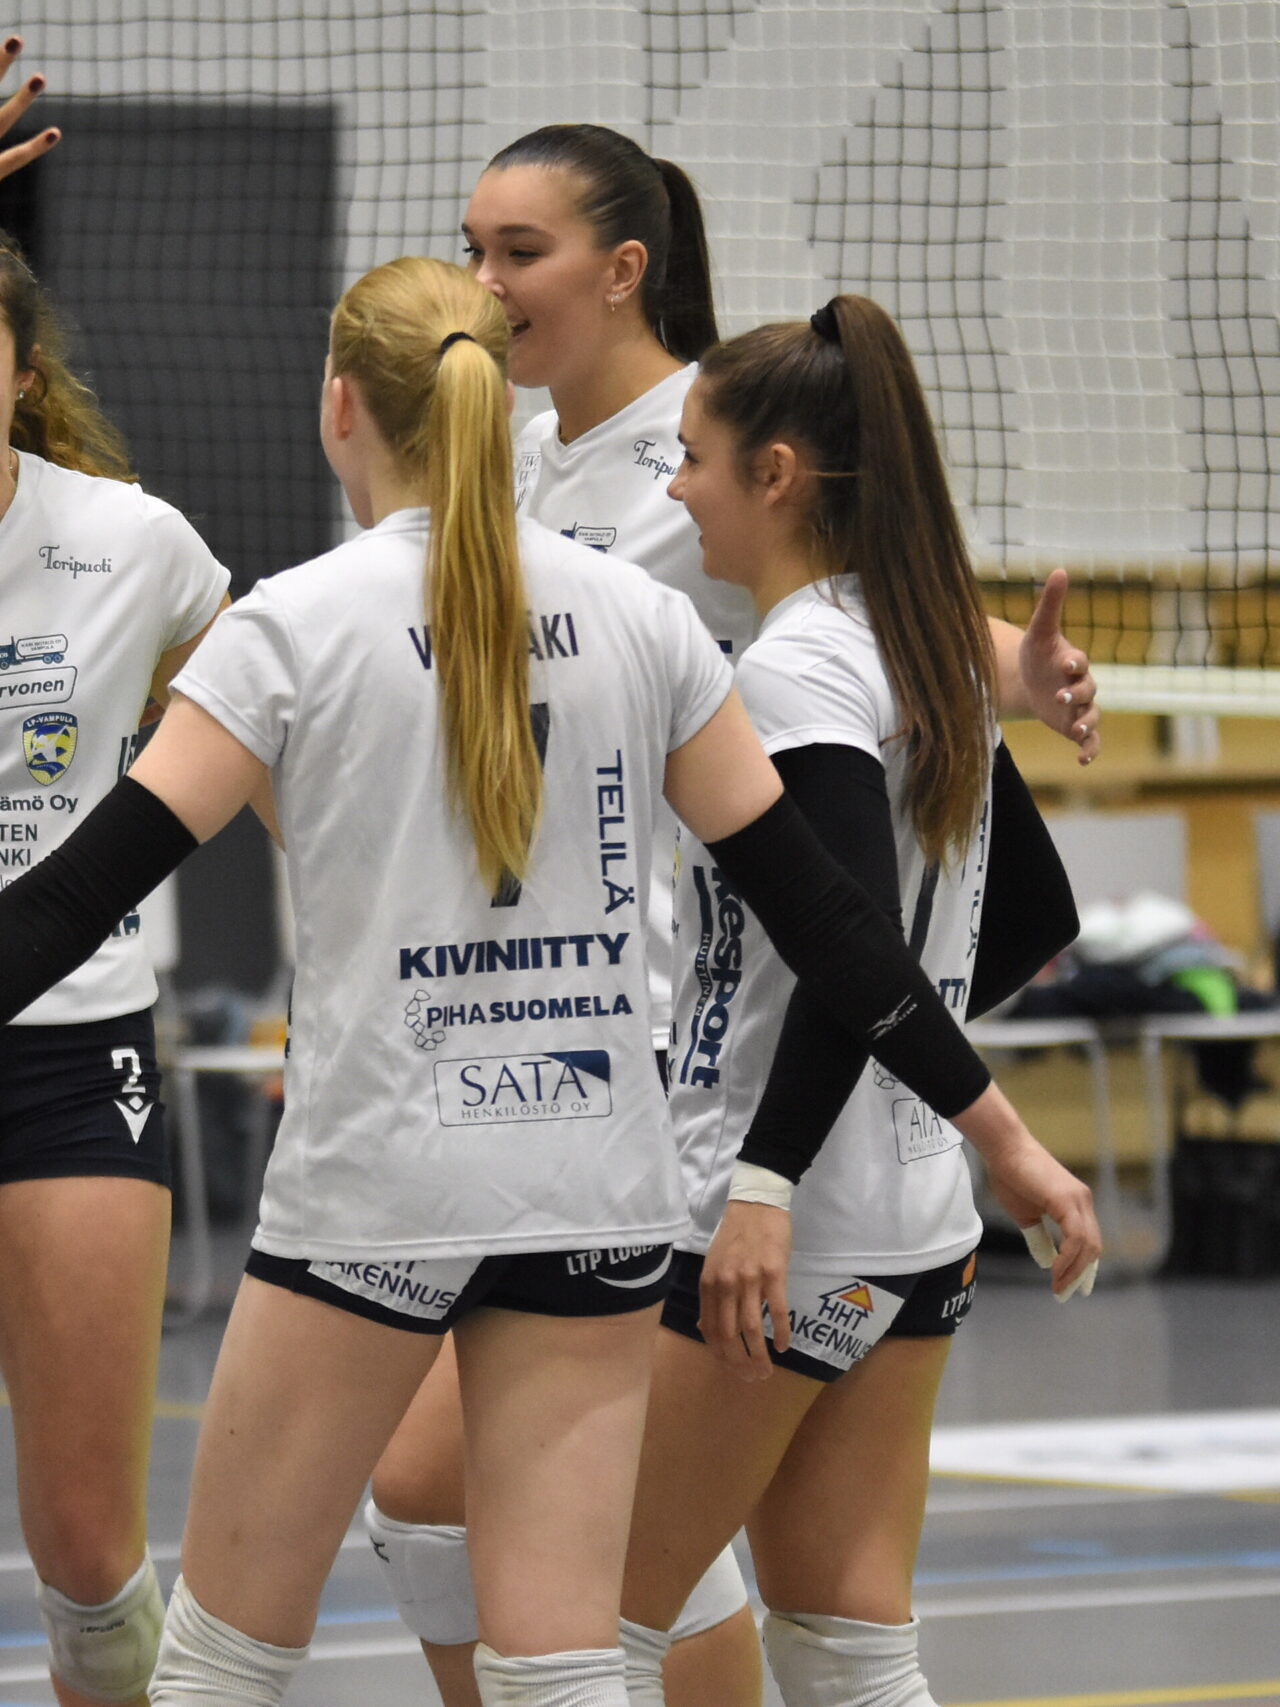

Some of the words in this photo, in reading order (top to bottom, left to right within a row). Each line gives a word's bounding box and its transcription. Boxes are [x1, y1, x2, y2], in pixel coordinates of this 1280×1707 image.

[39, 545, 112, 579] Toripuoti
[26, 714, 73, 728] LP-VAMPULA
[50, 794, 79, 813] Oy
[596, 749, 635, 915] TELILÄ
[400, 933, 630, 980] KIVINIITTY
[427, 994, 633, 1028] PIHASUOMELA
[460, 1059, 588, 1107] SATA
[461, 1102, 561, 1119] HENKILÖSTÖ
[571, 1101, 591, 1112] OY
[567, 1249, 602, 1275] LTP
[819, 1298, 869, 1331] HHT
[941, 1291, 967, 1319] LTP
